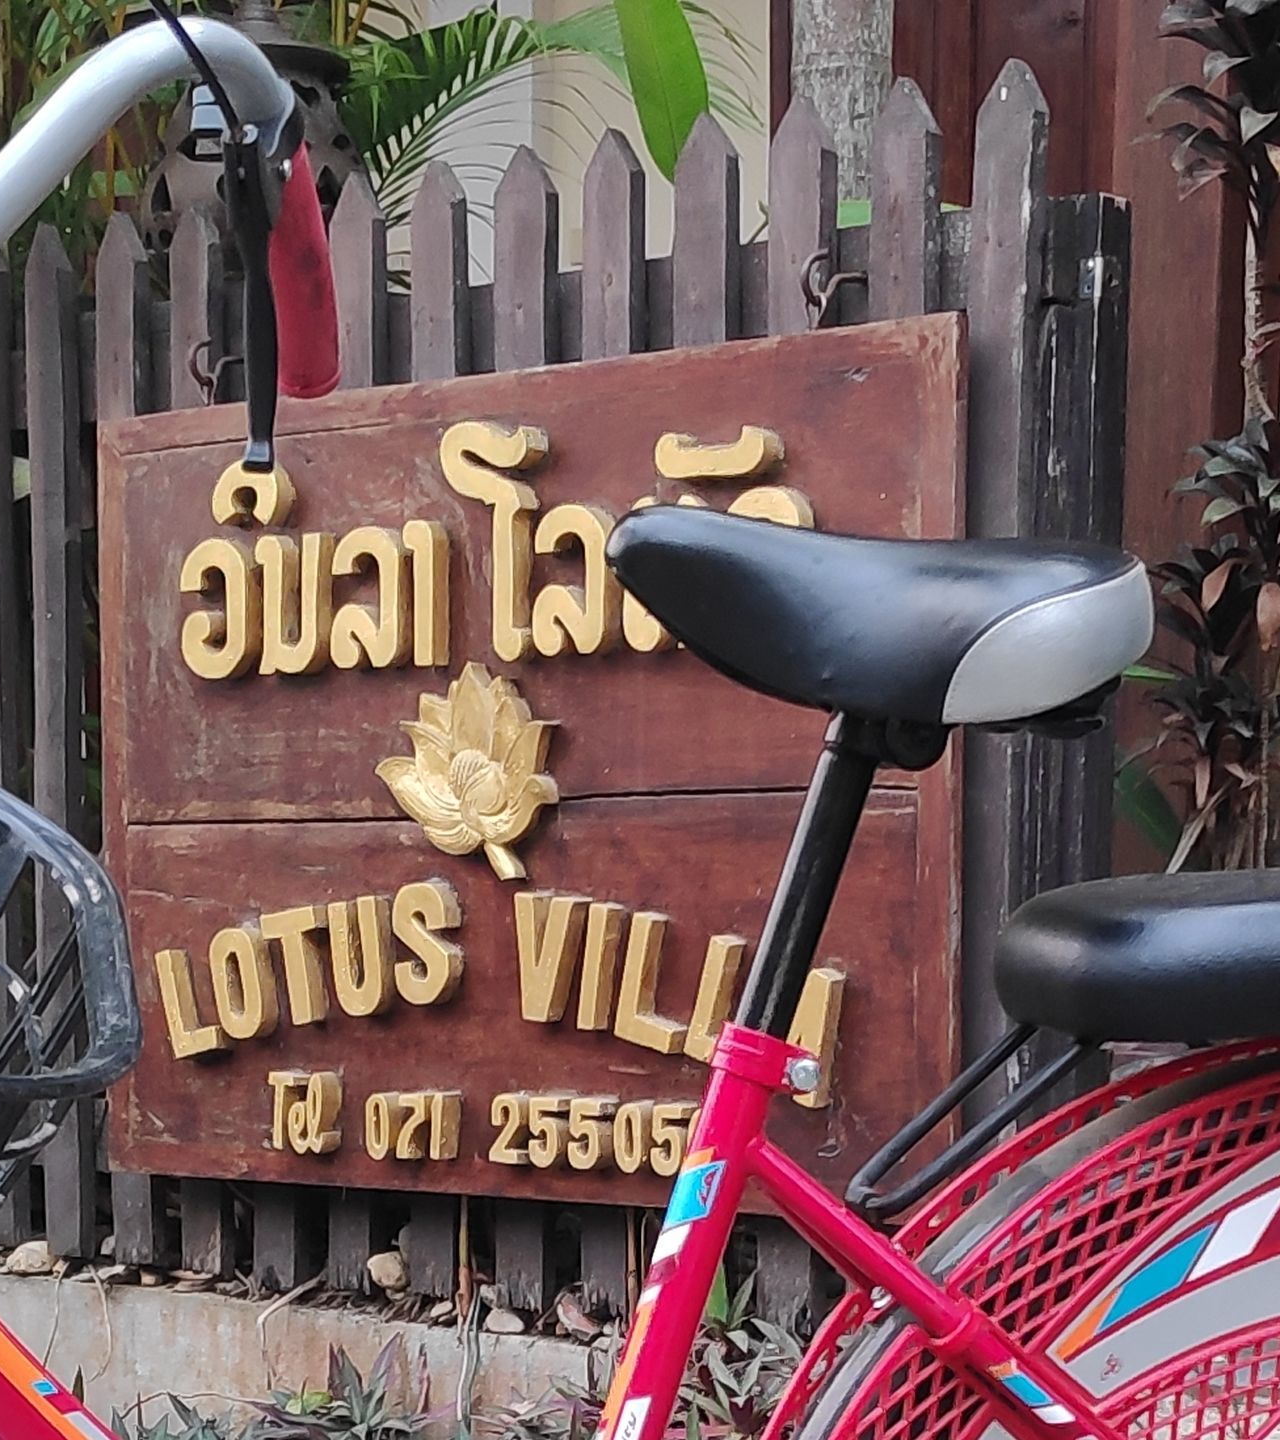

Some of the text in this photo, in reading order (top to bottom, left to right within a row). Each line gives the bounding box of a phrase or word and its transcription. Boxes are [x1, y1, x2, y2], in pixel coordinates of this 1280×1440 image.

[154, 880, 465, 1060] LOTUS
[267, 1069, 704, 1178] Tel 071 25505
